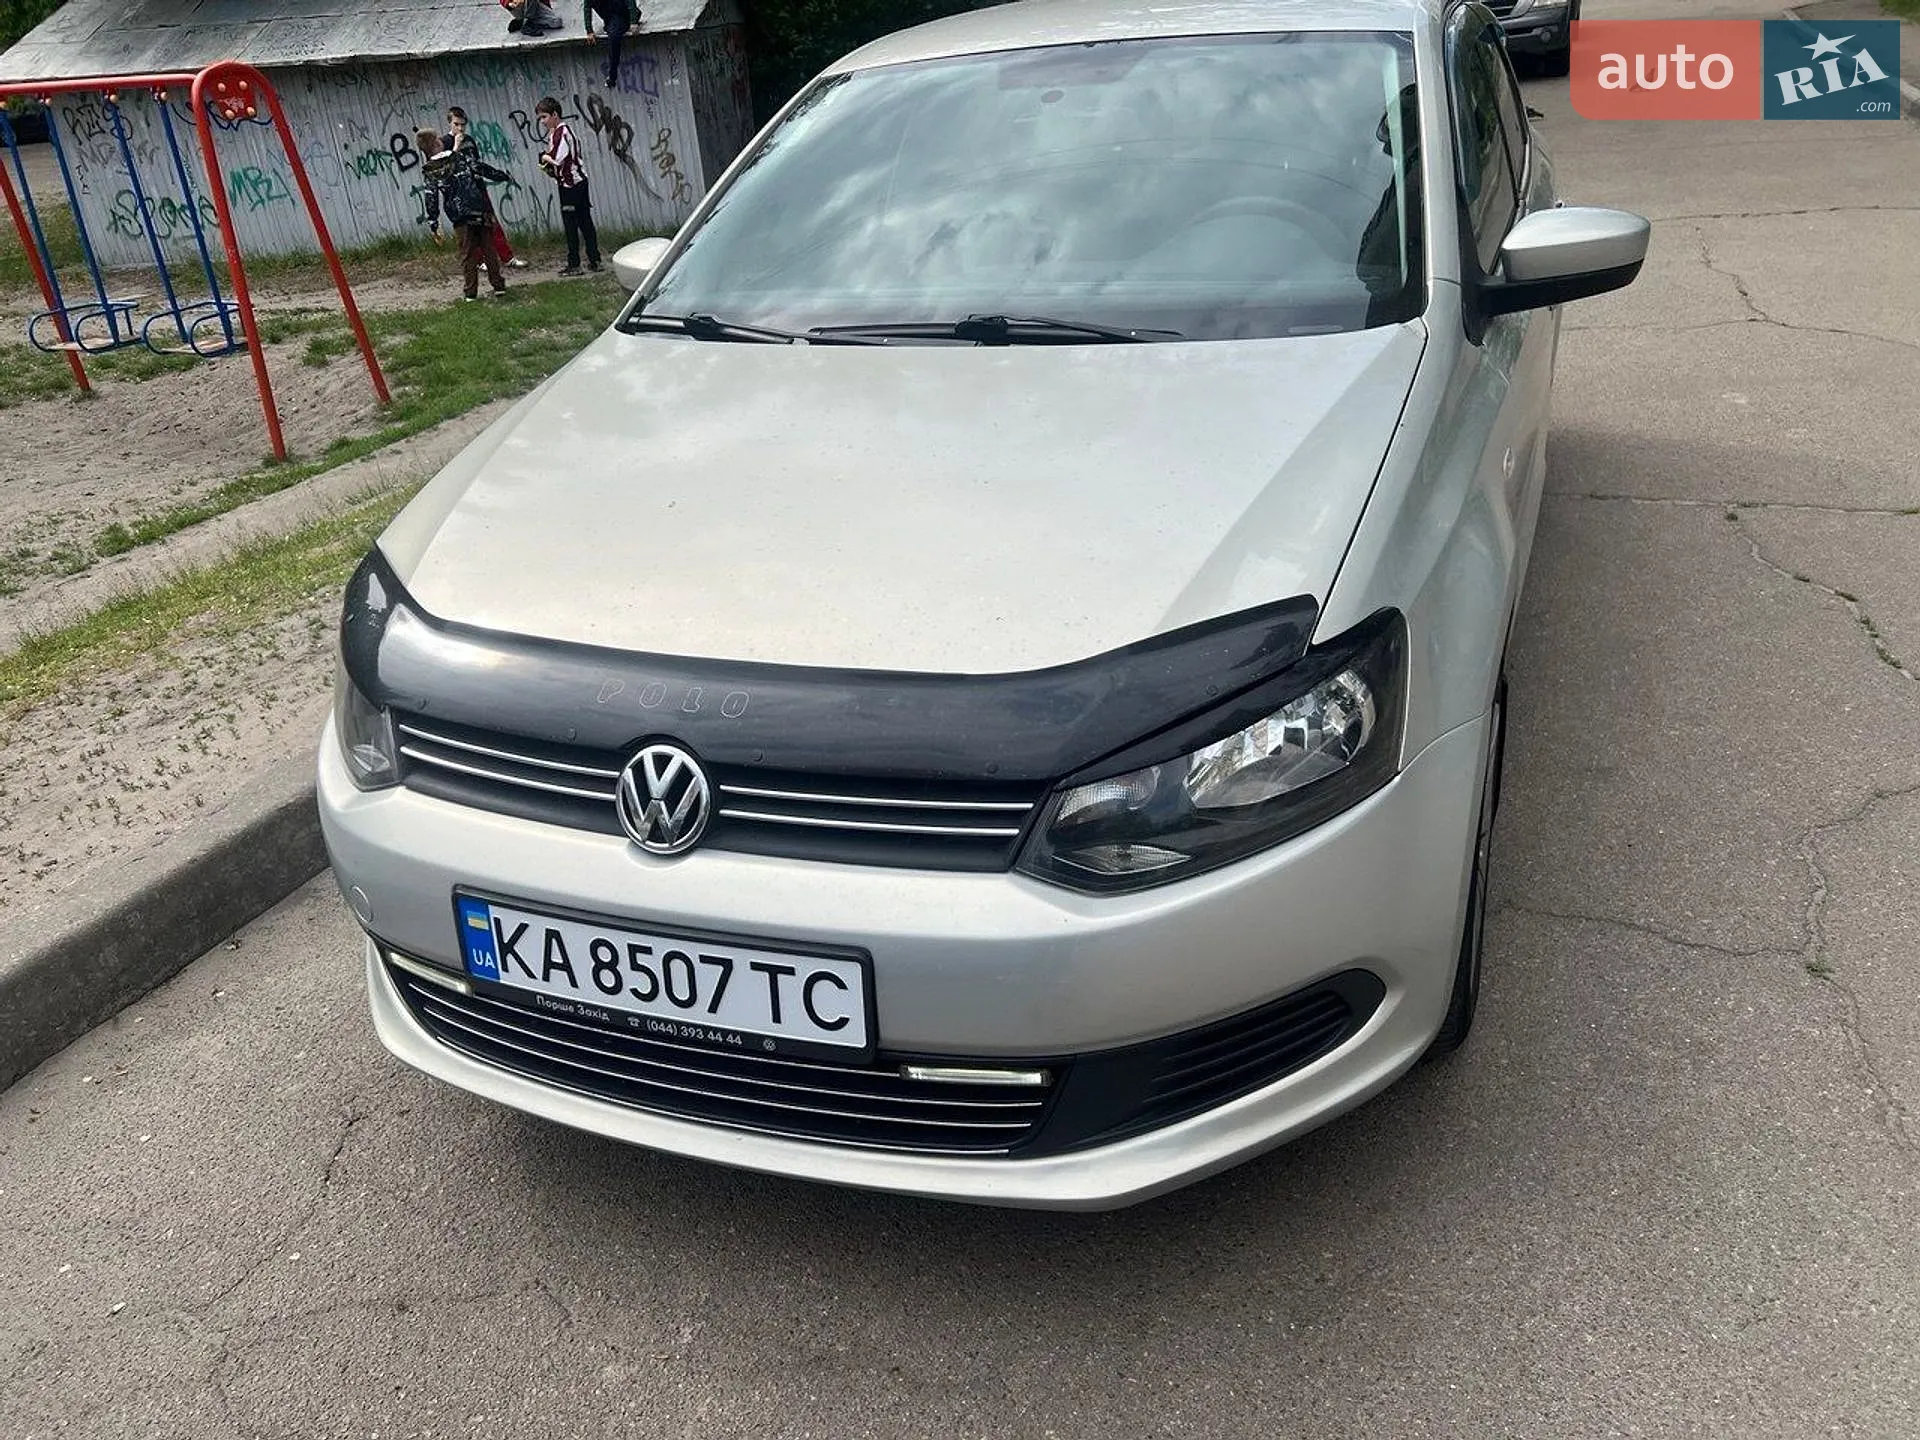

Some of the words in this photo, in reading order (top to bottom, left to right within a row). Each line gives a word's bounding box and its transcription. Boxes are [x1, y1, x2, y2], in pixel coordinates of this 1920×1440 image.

[597, 679, 750, 718] POLO
[472, 948, 496, 969] UA
[493, 916, 579, 988] KA
[589, 938, 733, 1014] 8507
[749, 960, 850, 1032] TC
[647, 1020, 678, 1036] (044)
[681, 1025, 705, 1039] 393
[707, 1031, 723, 1043] 44
[726, 1033, 743, 1046] 44
